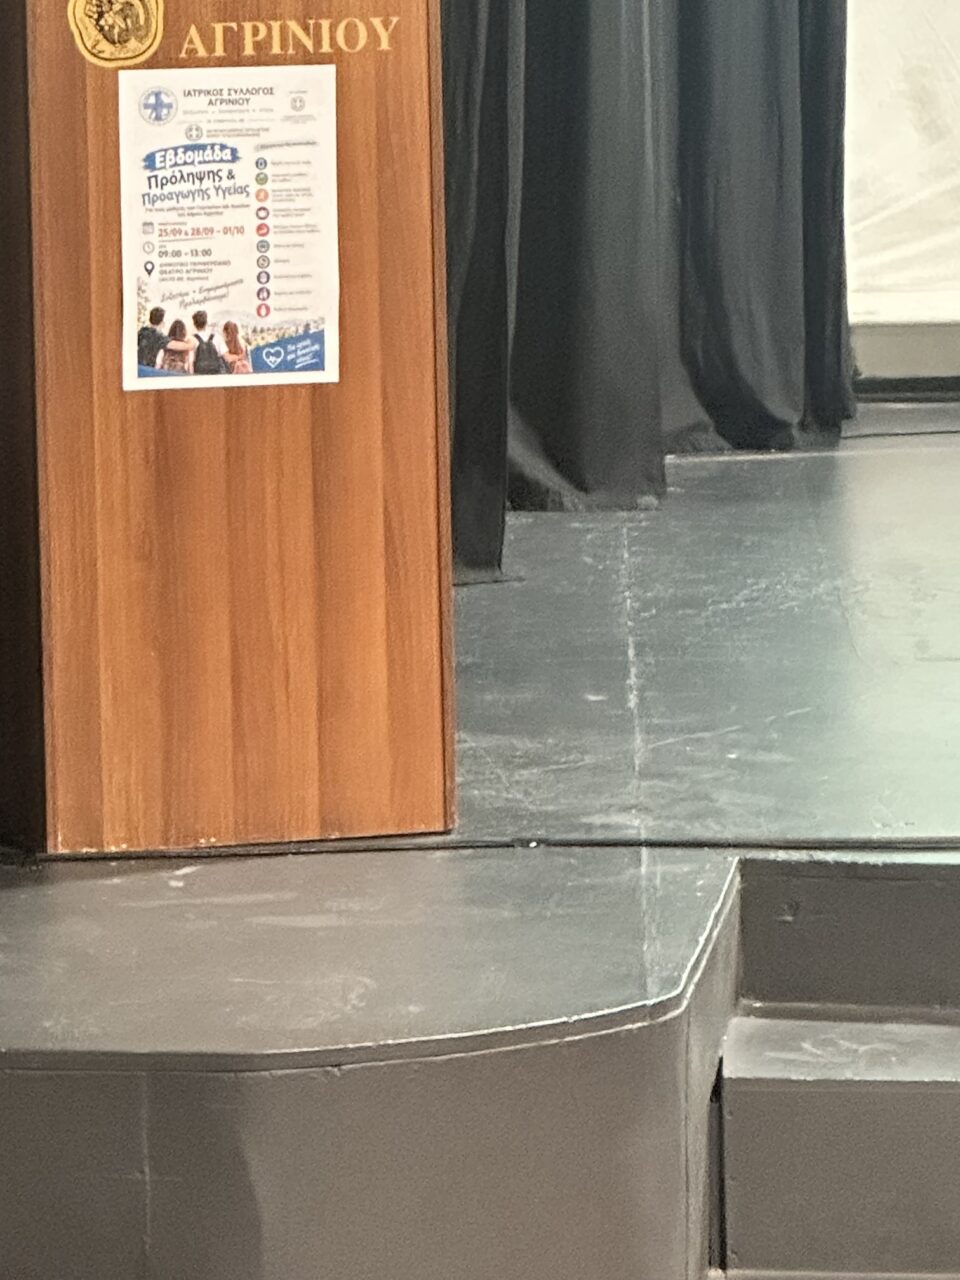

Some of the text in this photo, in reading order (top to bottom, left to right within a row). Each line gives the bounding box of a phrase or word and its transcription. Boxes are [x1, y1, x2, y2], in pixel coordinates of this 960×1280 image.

[179, 16, 400, 59] ΑΓΡΙΝΙΟΥ
[183, 86, 275, 98] ΙΑΤΡΙΚΟΣ ΣΥΛΛΟΓΟΣ
[208, 97, 251, 107] ΑΓΡΙΝΙΟΥ
[155, 145, 232, 169] Εβδομάδα
[147, 168, 235, 190] Πρόληψης &
[142, 186, 211, 207] Προαγωγής
[213, 182, 250, 200] Υγείας
